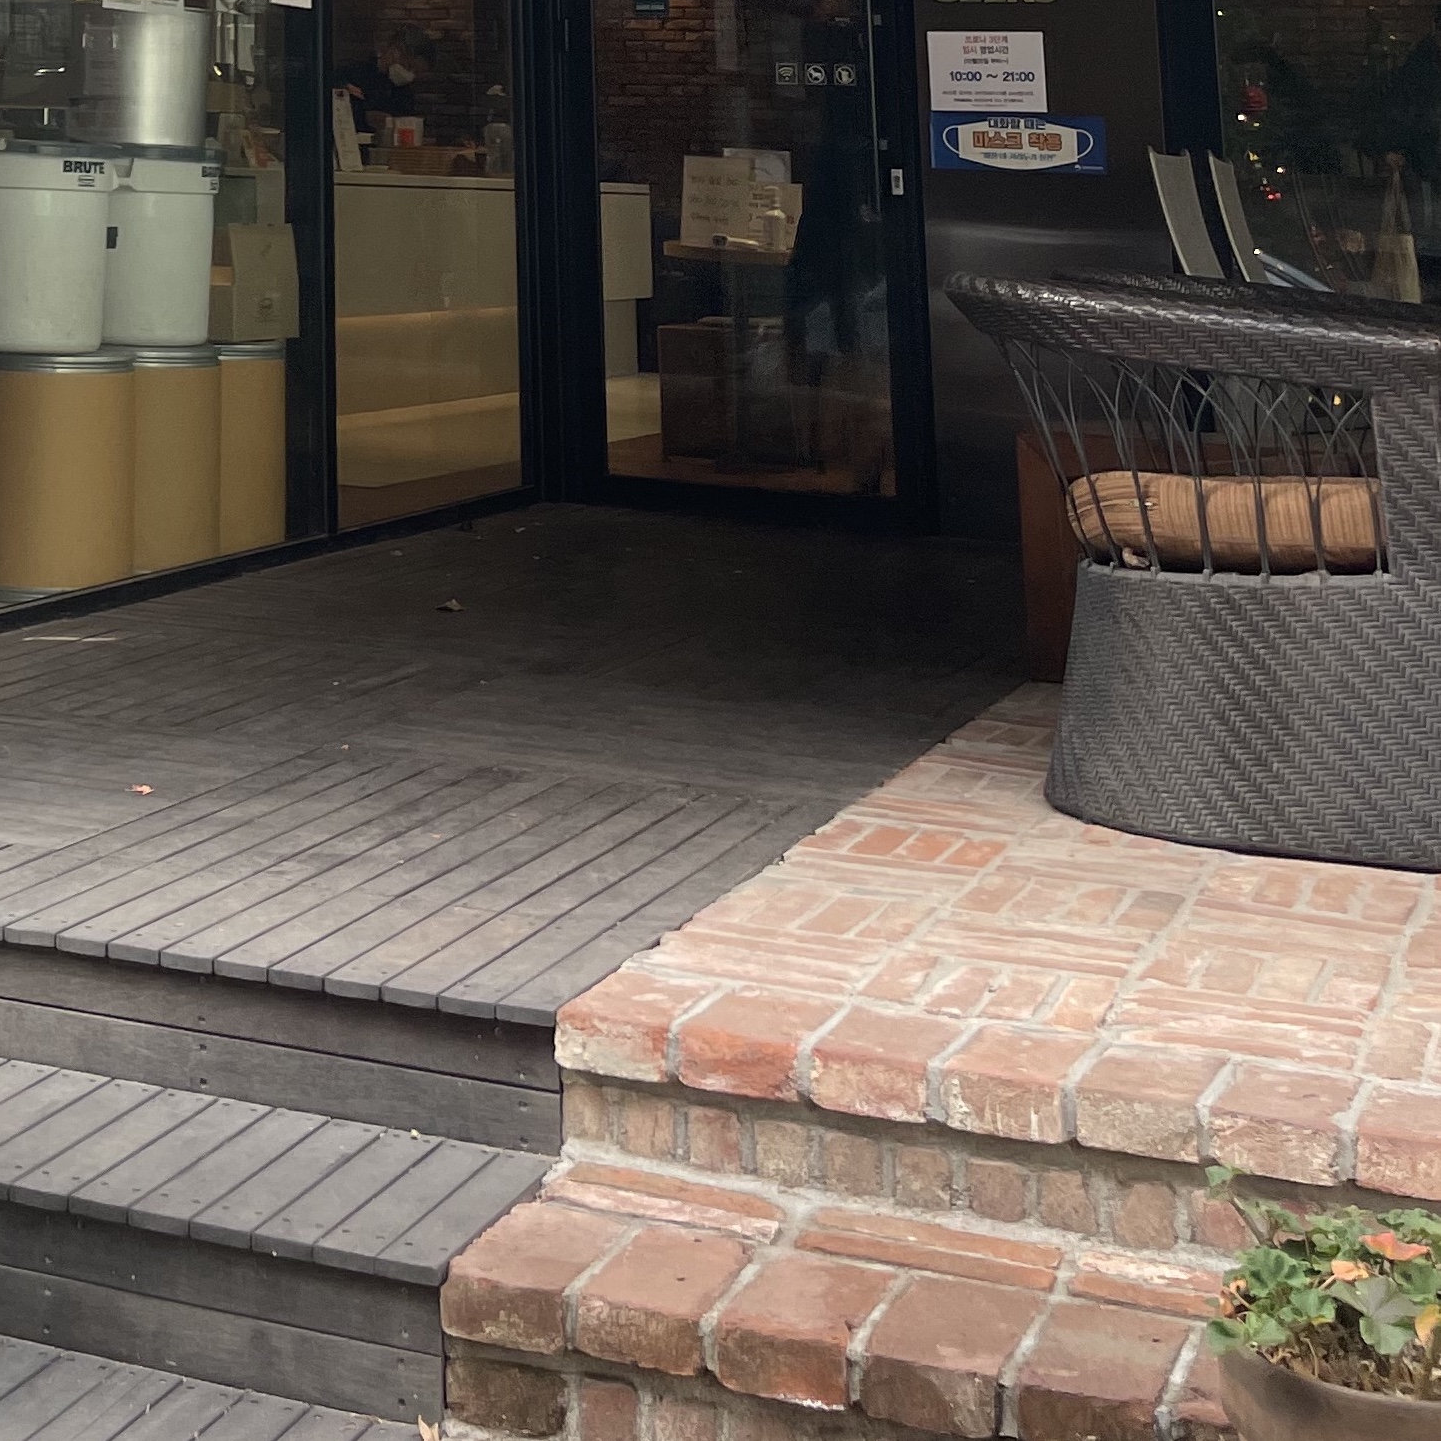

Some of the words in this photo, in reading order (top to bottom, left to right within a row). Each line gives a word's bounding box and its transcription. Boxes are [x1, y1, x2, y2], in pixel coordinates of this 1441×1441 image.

[979, 45, 1009, 55] 영업시간
[949, 71, 982, 82] 10:00
[1002, 71, 1035, 83] 21:00
[987, 117, 1022, 129] 대화할
[1024, 118, 1047, 131] 때는
[972, 130, 1023, 150] 마스크
[1028, 133, 1063, 151] 착용
[62, 160, 105, 175] BRUTE
